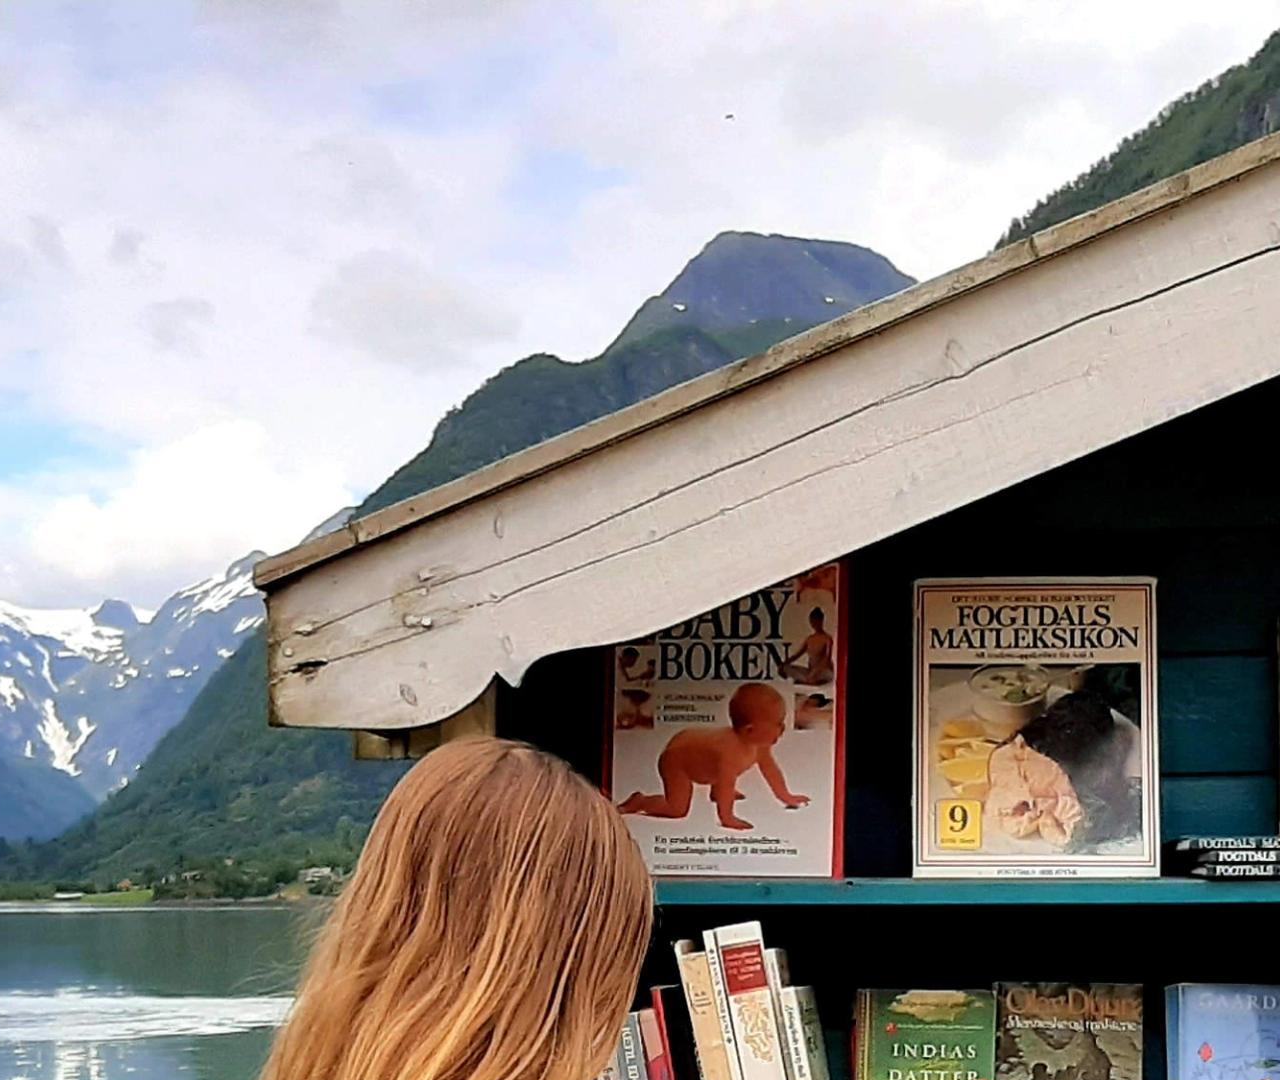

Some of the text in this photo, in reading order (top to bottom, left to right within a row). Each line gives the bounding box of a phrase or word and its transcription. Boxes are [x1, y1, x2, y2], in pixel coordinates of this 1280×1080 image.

[957, 604, 1112, 627] FOGTDALS
[929, 626, 1140, 649] MATLEKSIKON
[658, 642, 793, 680] BOKEN
[948, 805, 969, 832] 9
[1218, 850, 1276, 861] FOGTDALS
[1216, 864, 1274, 876] FOGTDALS
[892, 1043, 977, 1059] INDIAS
